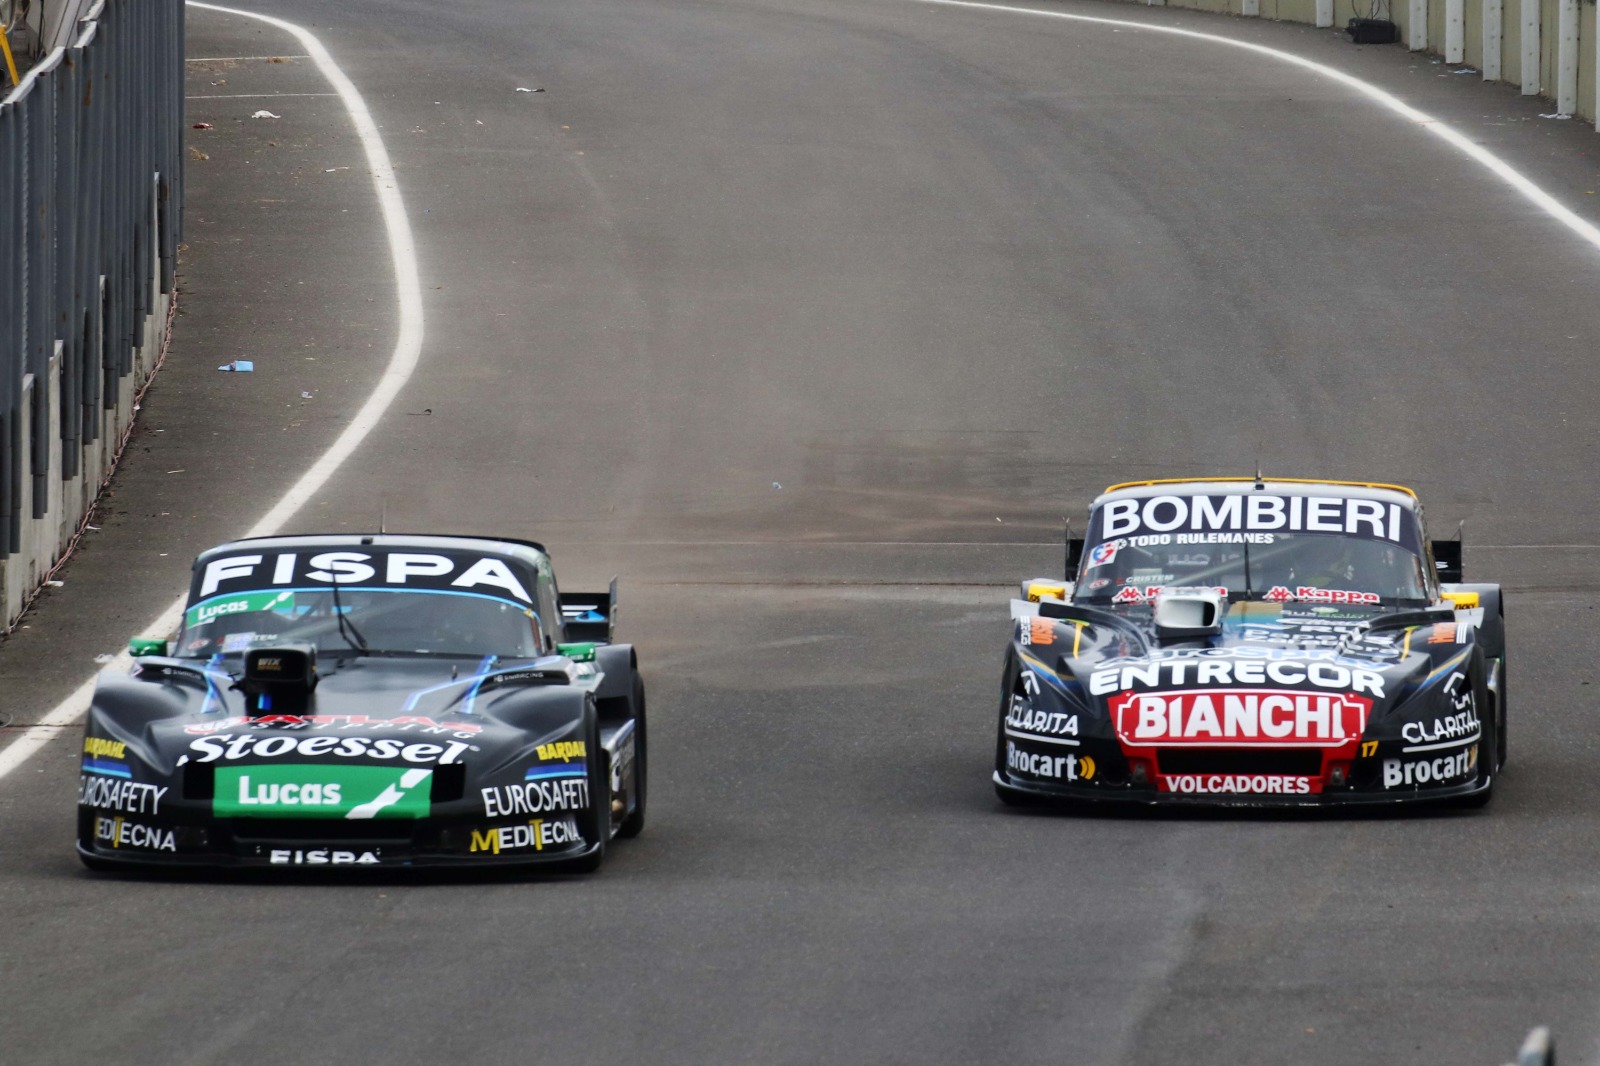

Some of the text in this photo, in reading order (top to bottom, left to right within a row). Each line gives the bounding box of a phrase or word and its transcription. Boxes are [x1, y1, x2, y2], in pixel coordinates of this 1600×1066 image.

[1103, 495, 1401, 542] BOMBIERI
[1128, 532, 1275, 548] TODO RULEMANES
[199, 551, 533, 604] FISPA
[198, 599, 248, 621] Lucas
[1297, 586, 1380, 604] Kappa
[1089, 659, 1387, 699] ENTRECOR
[1008, 704, 1078, 736] CLARITA
[1135, 694, 1346, 739] BIANCHI
[1402, 710, 1477, 743] CLARITA
[1008, 740, 1078, 780] Brocart
[1361, 741, 1379, 757] 17
[1383, 748, 1469, 787] Brocart
[239, 775, 341, 805] Lucas
[481, 770, 588, 818] EUROSAFETY
[1165, 775, 1311, 794] VOLCADORES
[469, 818, 580, 855] MEDITECNA
[269, 849, 380, 865] FISPA
